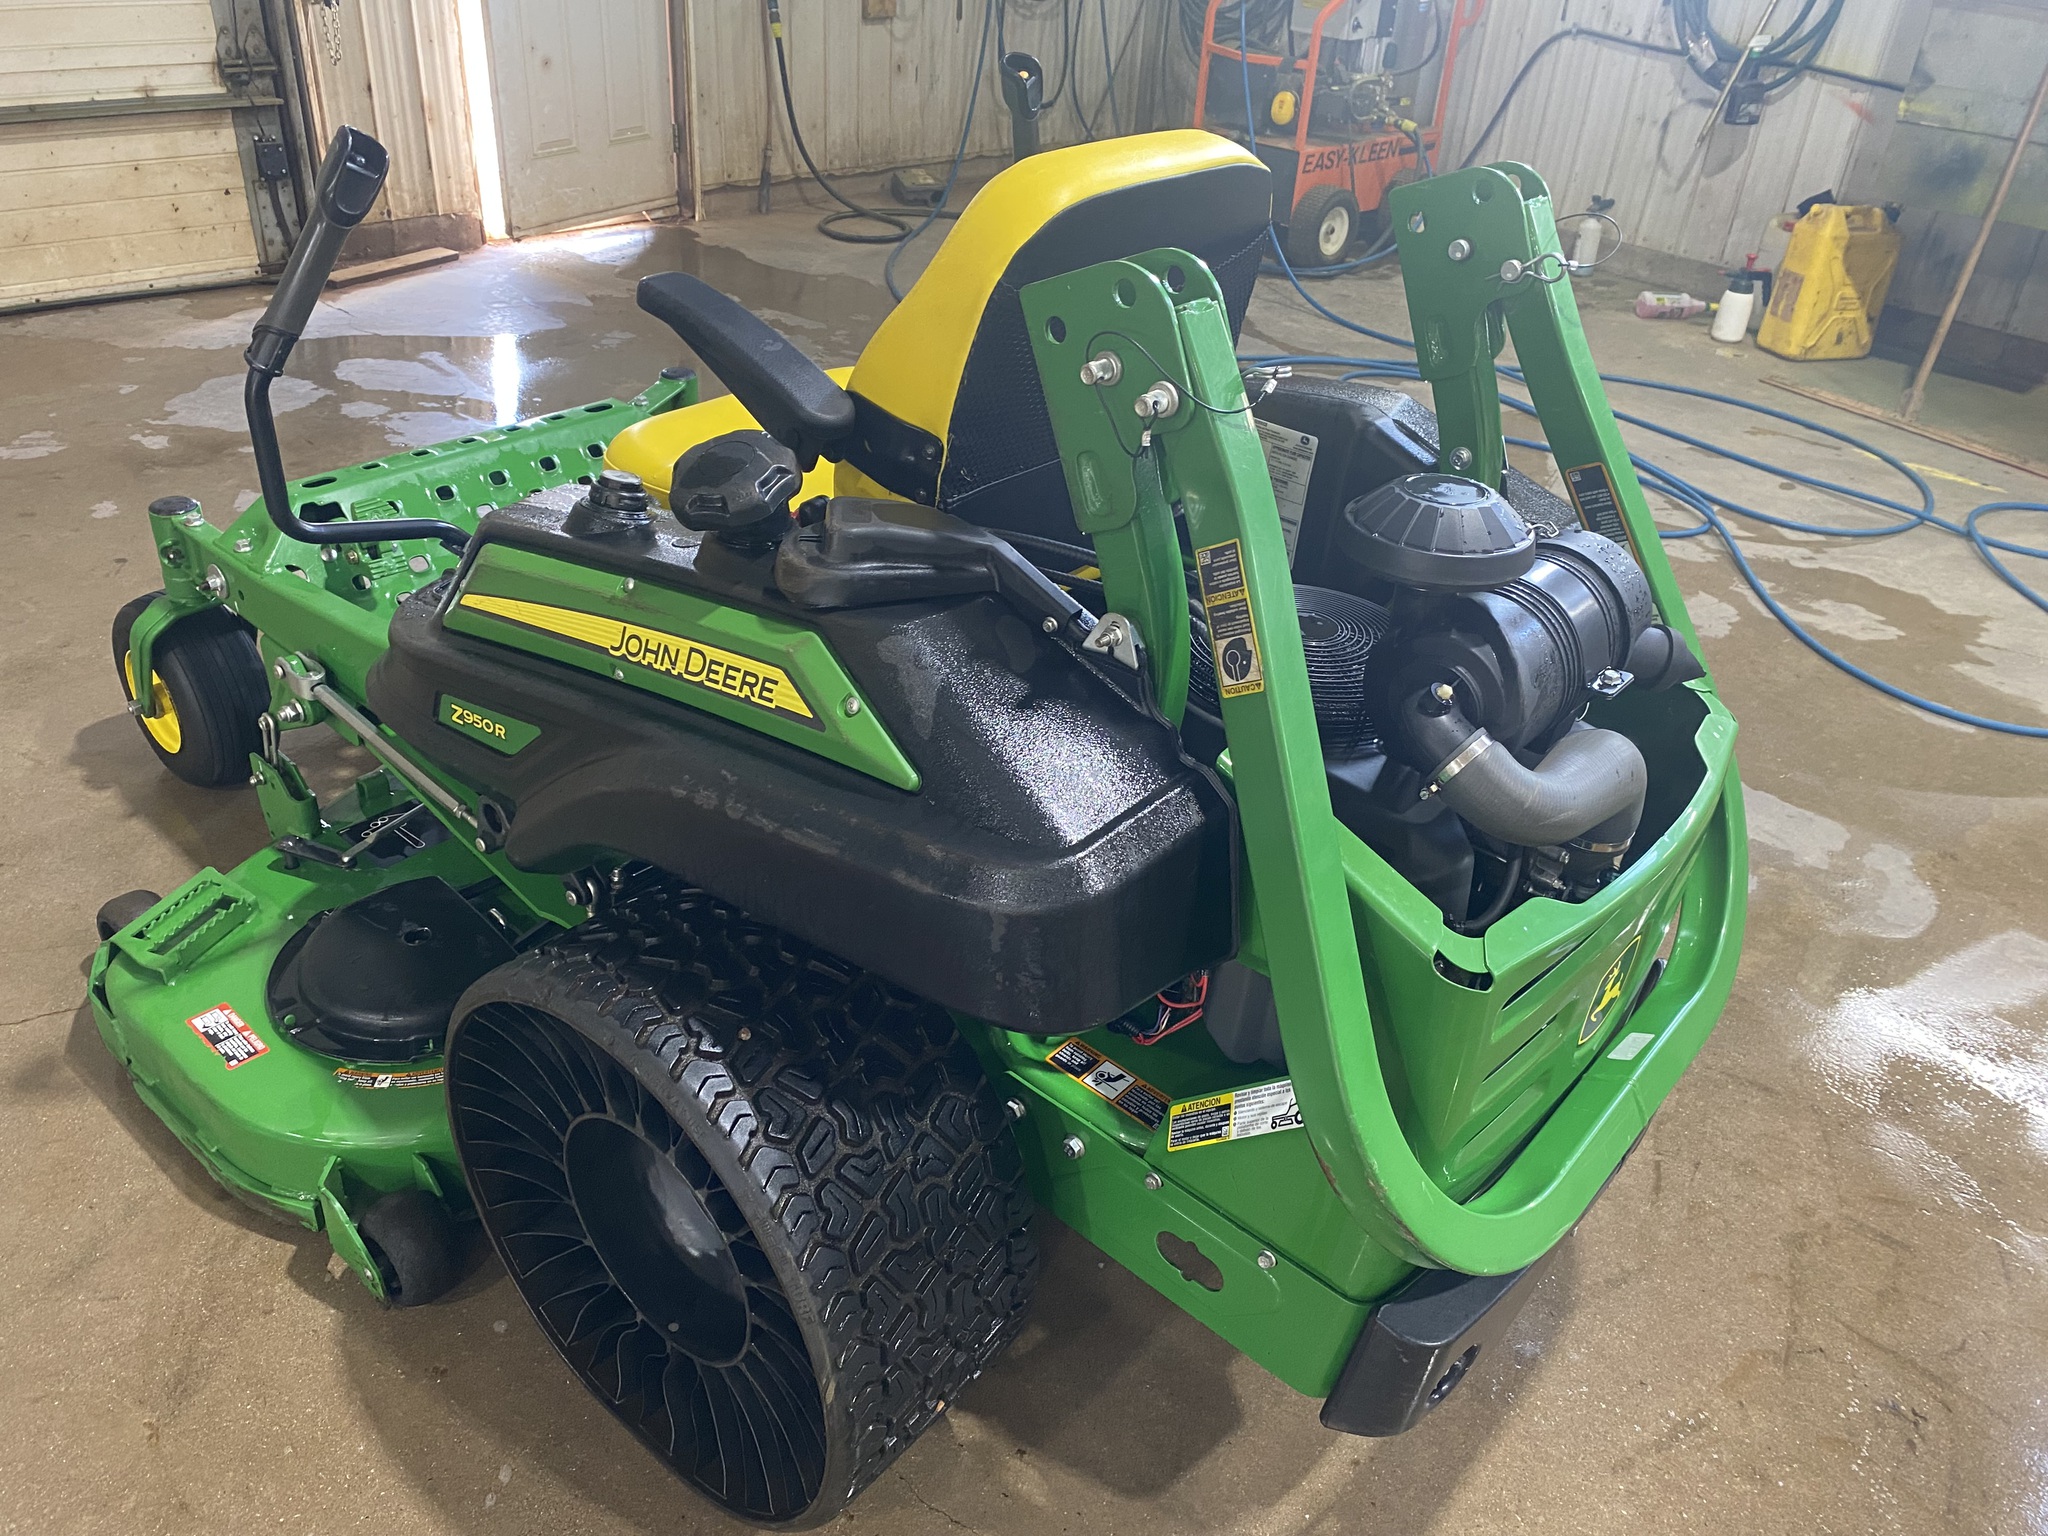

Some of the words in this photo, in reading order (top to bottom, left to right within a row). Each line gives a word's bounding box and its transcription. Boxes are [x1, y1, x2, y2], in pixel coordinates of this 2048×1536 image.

[1302, 139, 1399, 174] EASY-KLEEN
[609, 625, 680, 671] JOHN
[684, 646, 779, 704] DEERE
[1224, 683, 1256, 696] CAUTION
[450, 703, 506, 740] Z950R
[1187, 1097, 1221, 1111] ATENCION
